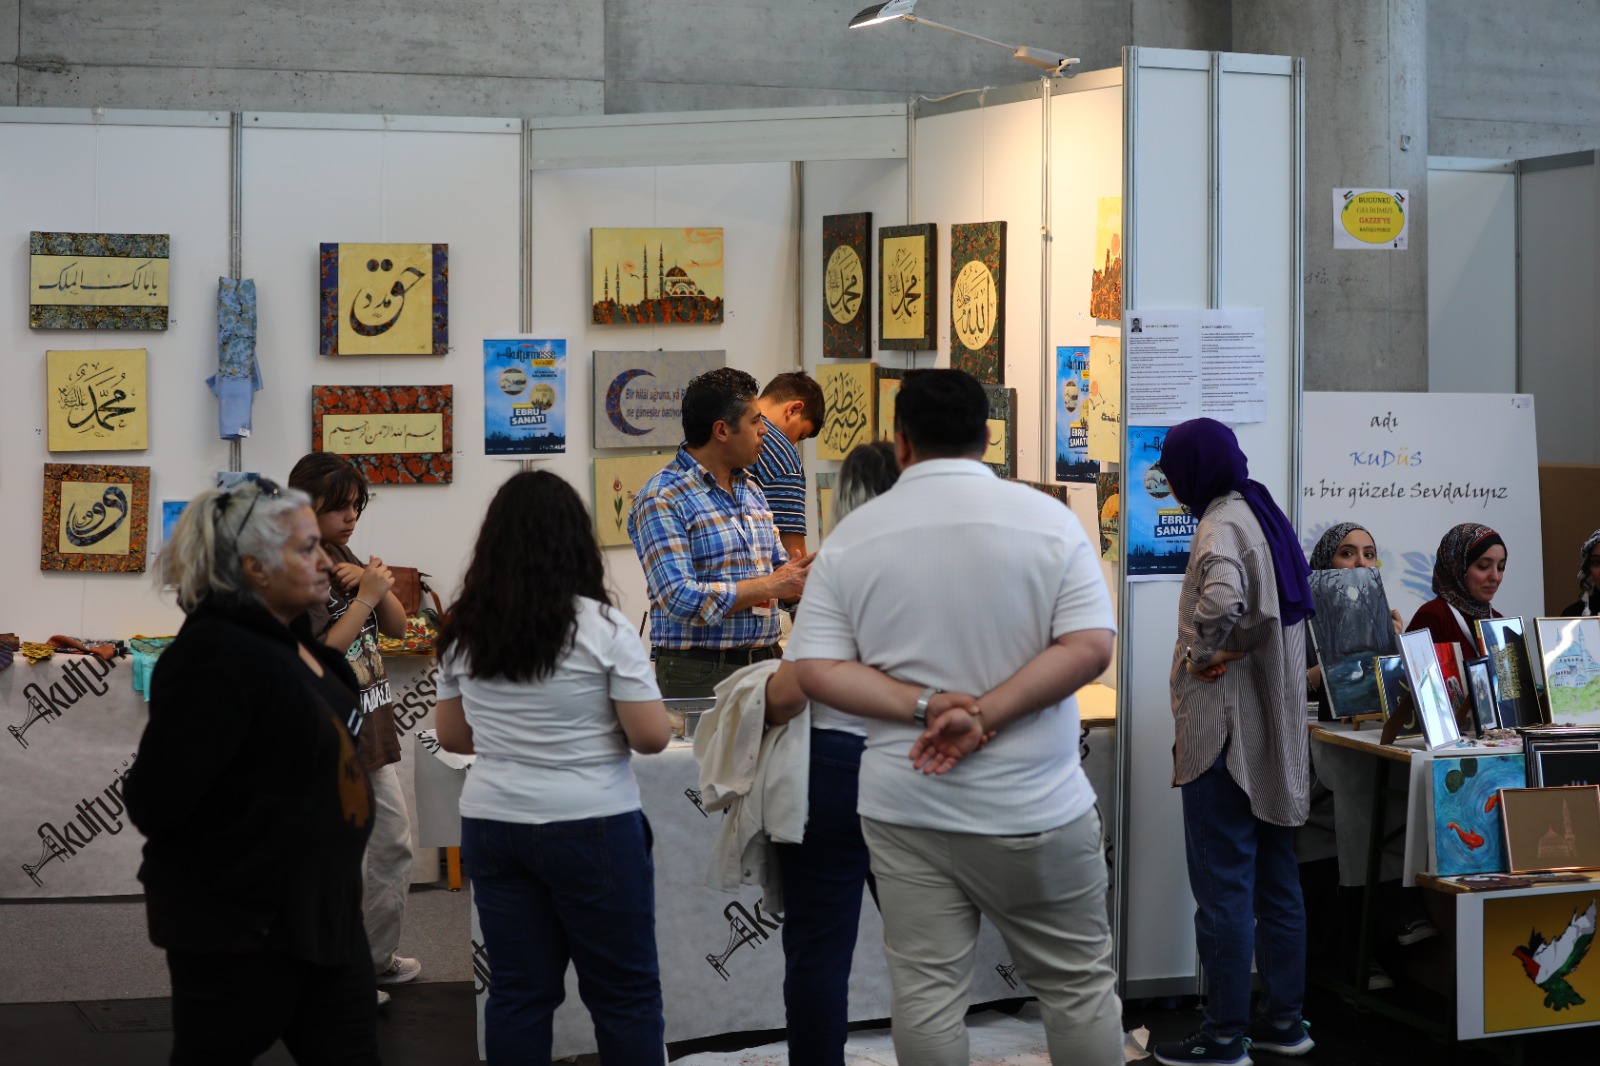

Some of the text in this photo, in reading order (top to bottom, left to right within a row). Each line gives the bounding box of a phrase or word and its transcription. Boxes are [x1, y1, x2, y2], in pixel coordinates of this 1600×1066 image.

[1358, 196, 1391, 204] BUGÜNKÜ
[515, 408, 540, 416] EBRU
[511, 415, 545, 425] SANATI
[1370, 411, 1399, 433] adı
[1071, 428, 1086, 437] EBRU
[1319, 478, 1345, 498] bir
[1348, 482, 1406, 509] güzele
[1409, 482, 1509, 509] Sevdalıyız
[1161, 515, 1191, 525] EBRU
[1156, 524, 1197, 536] SANATI
